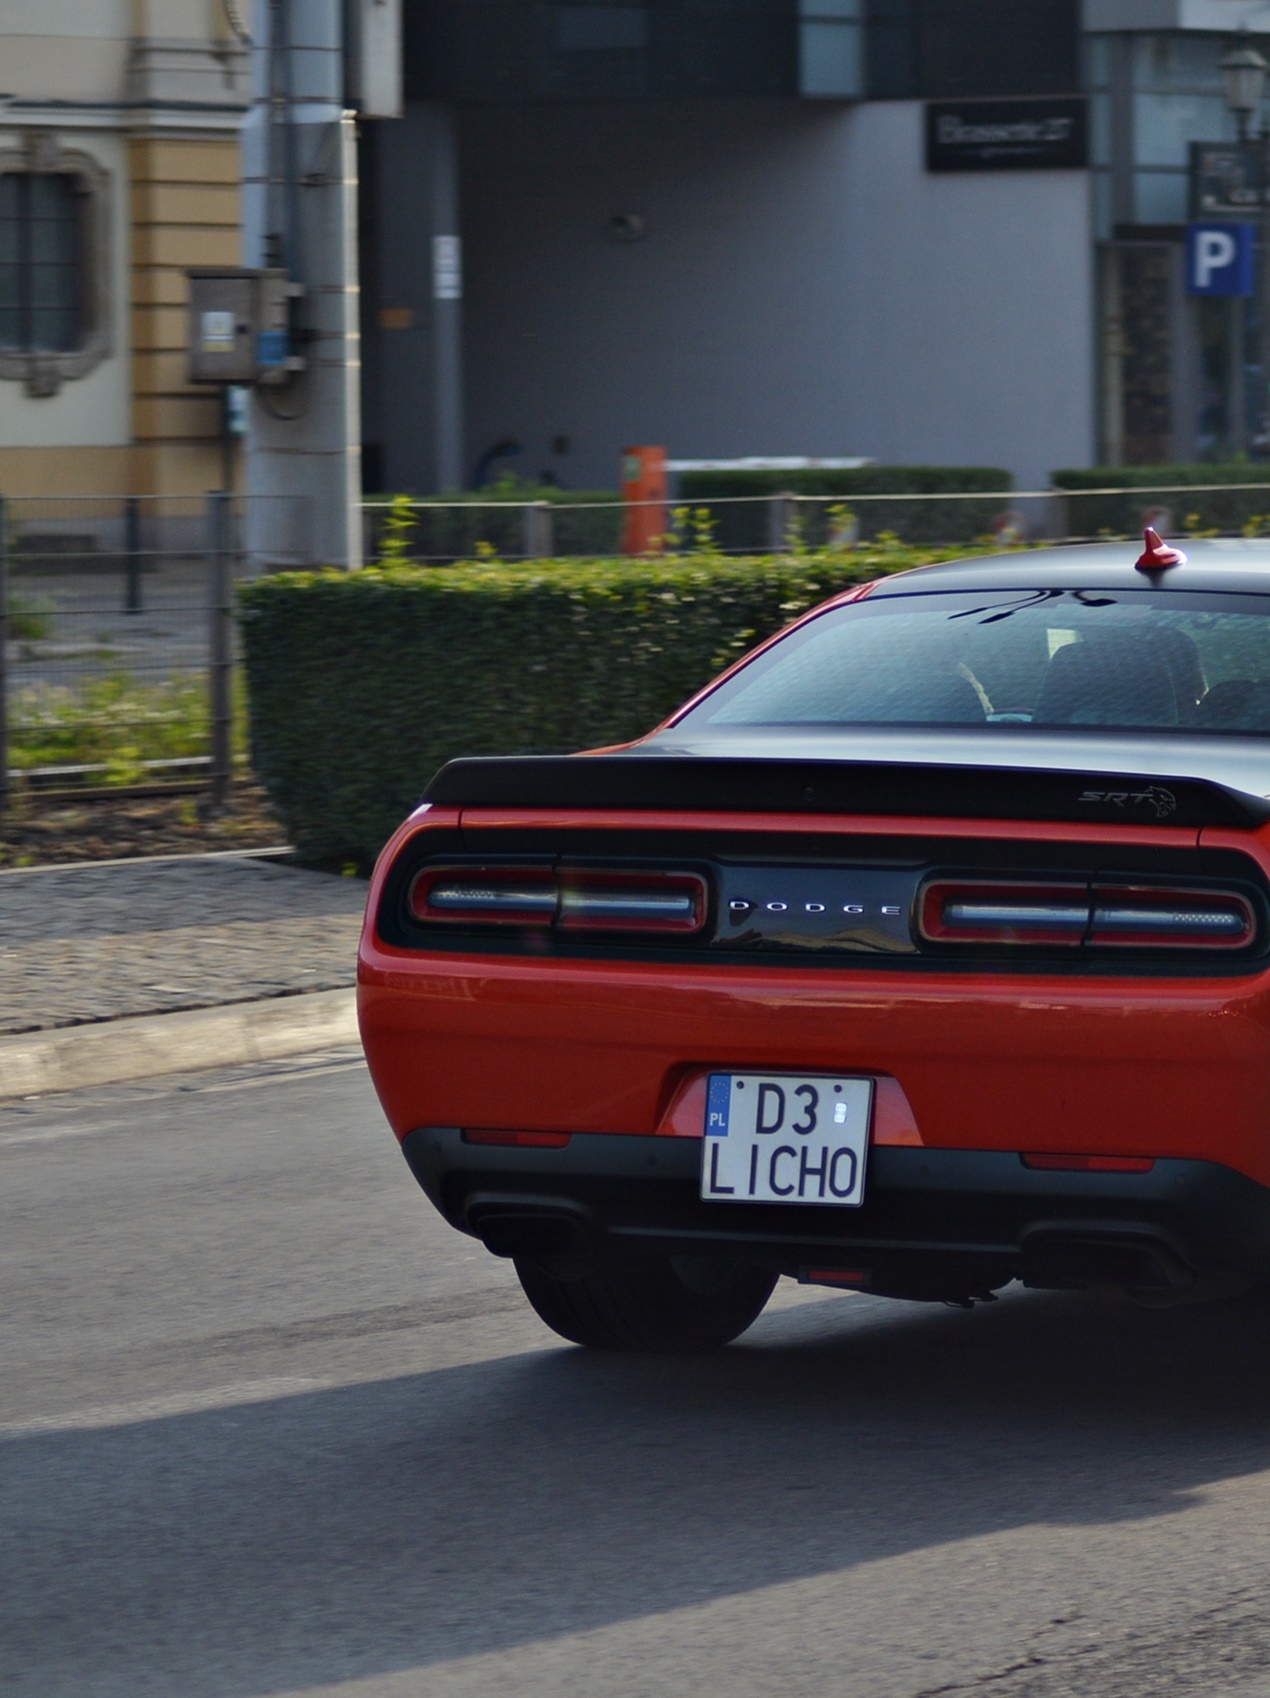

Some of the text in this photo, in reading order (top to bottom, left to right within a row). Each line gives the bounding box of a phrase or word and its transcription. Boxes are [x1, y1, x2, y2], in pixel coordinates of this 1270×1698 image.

[1194, 231, 1236, 288] P
[1078, 791, 1154, 807] SRT
[729, 901, 901, 916] DODGE
[709, 1112, 726, 1127] PL
[755, 1082, 819, 1136] D3
[709, 1142, 858, 1198] LICHO
